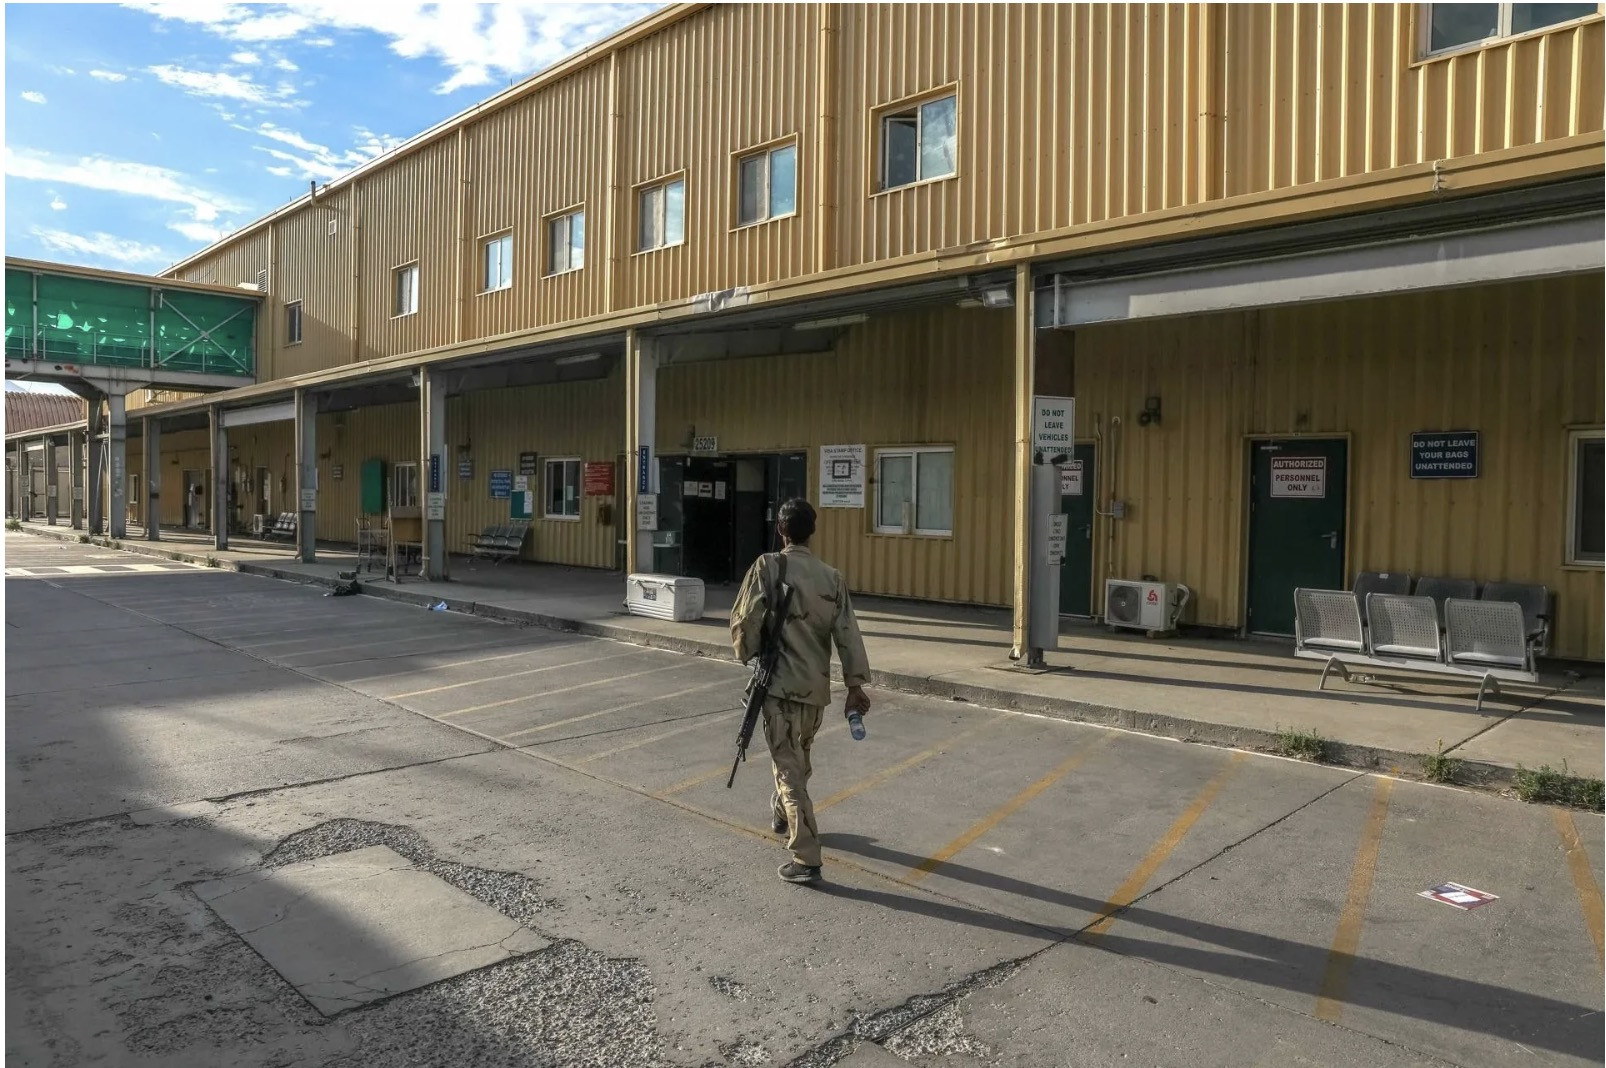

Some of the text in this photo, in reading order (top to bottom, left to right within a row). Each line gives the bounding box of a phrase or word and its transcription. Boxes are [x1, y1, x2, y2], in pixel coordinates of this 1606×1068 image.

[1052, 409, 1064, 417] NOT
[1044, 421, 1064, 429] LEAVE
[1038, 433, 1068, 441] VEHICLES
[695, 438, 715, 450] 25209
[1447, 439, 1475, 447] LEAVE
[1419, 451, 1469, 459] YOUR BAGS
[1273, 460, 1324, 468] AUTHORIZED
[1415, 462, 1473, 470] UNATTENDED
[1275, 474, 1320, 482] PERSONNEL
